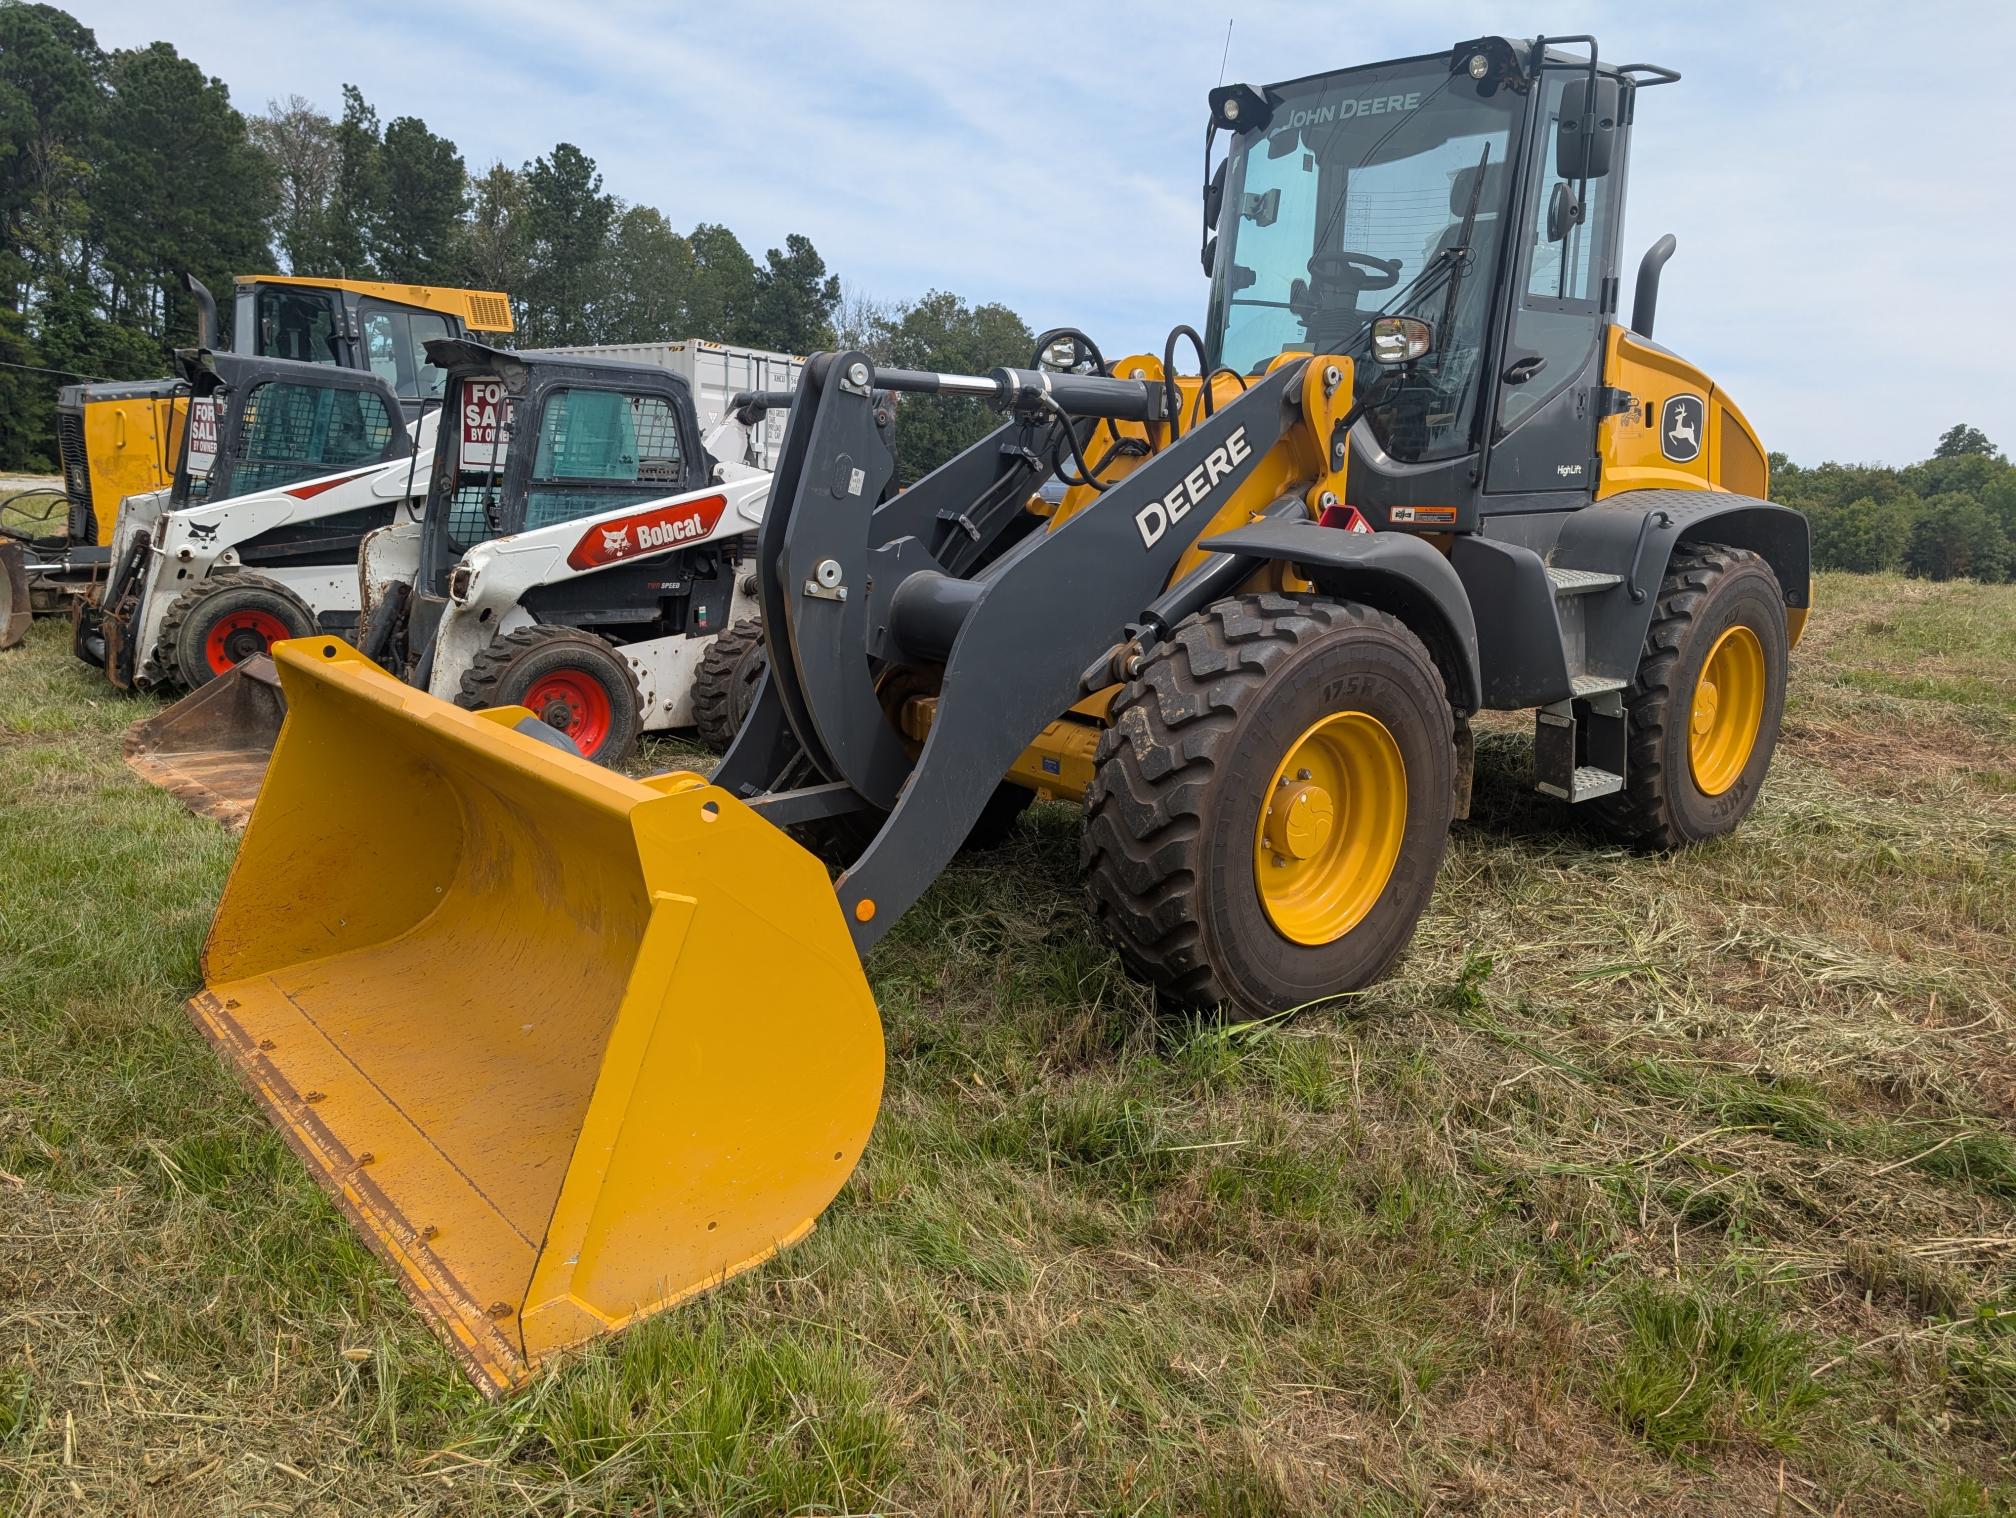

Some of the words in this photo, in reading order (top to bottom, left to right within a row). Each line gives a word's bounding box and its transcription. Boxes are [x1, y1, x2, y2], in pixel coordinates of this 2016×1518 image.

[1285, 105, 1336, 129] JOHN
[1340, 92, 1421, 120] DEERE
[196, 404, 216, 422] FOR
[466, 405, 514, 427] SAE
[471, 428, 483, 441] BY
[200, 441, 218, 453] OWNER
[1135, 426, 1252, 548] DEERE
[636, 513, 704, 550] Bobcat
